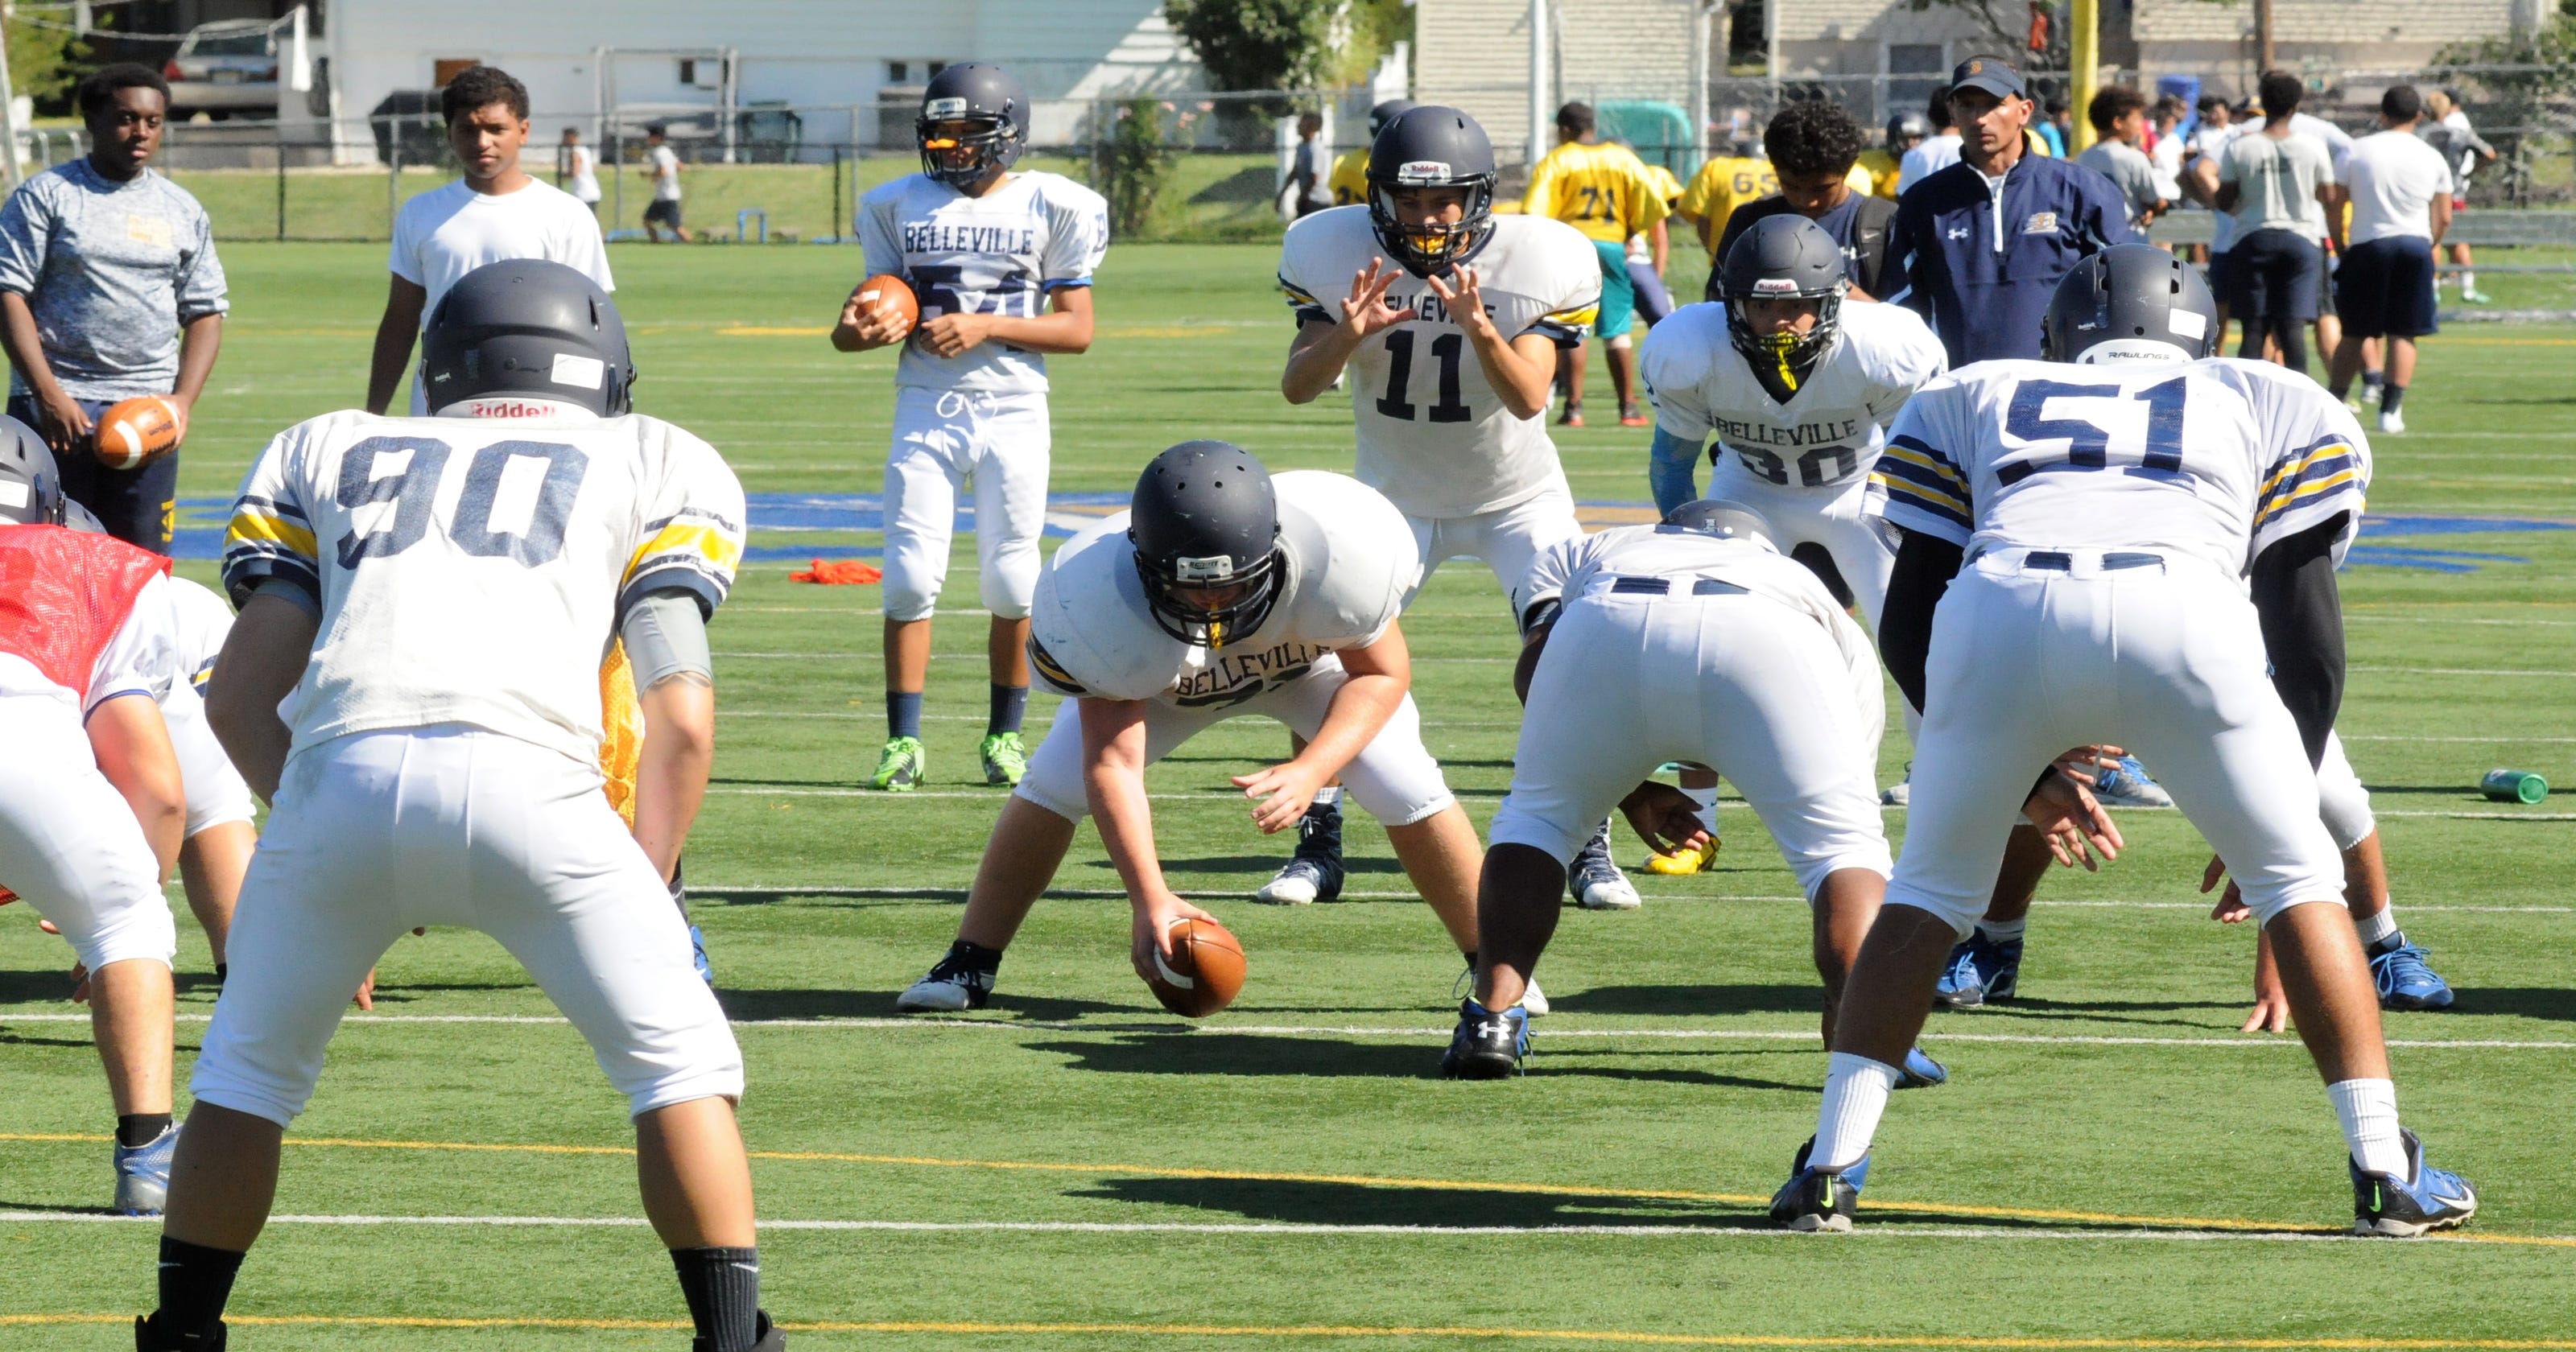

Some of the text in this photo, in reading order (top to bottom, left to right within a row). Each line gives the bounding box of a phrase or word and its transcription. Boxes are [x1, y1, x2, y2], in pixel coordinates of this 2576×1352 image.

[1411, 165, 1439, 173] Riddell
[1733, 172, 1782, 200] 65
[1578, 187, 1615, 224] 71
[905, 225, 1034, 255] BELLEVILLE
[1758, 282, 1792, 291] Riddell
[2108, 352, 2170, 361] RAWLINGS
[1376, 328, 1472, 422] 11
[1715, 416, 1858, 447] BELLEVILLE
[1996, 376, 2197, 496] 51
[1728, 443, 1858, 487] 30
[336, 435, 590, 570] 90
